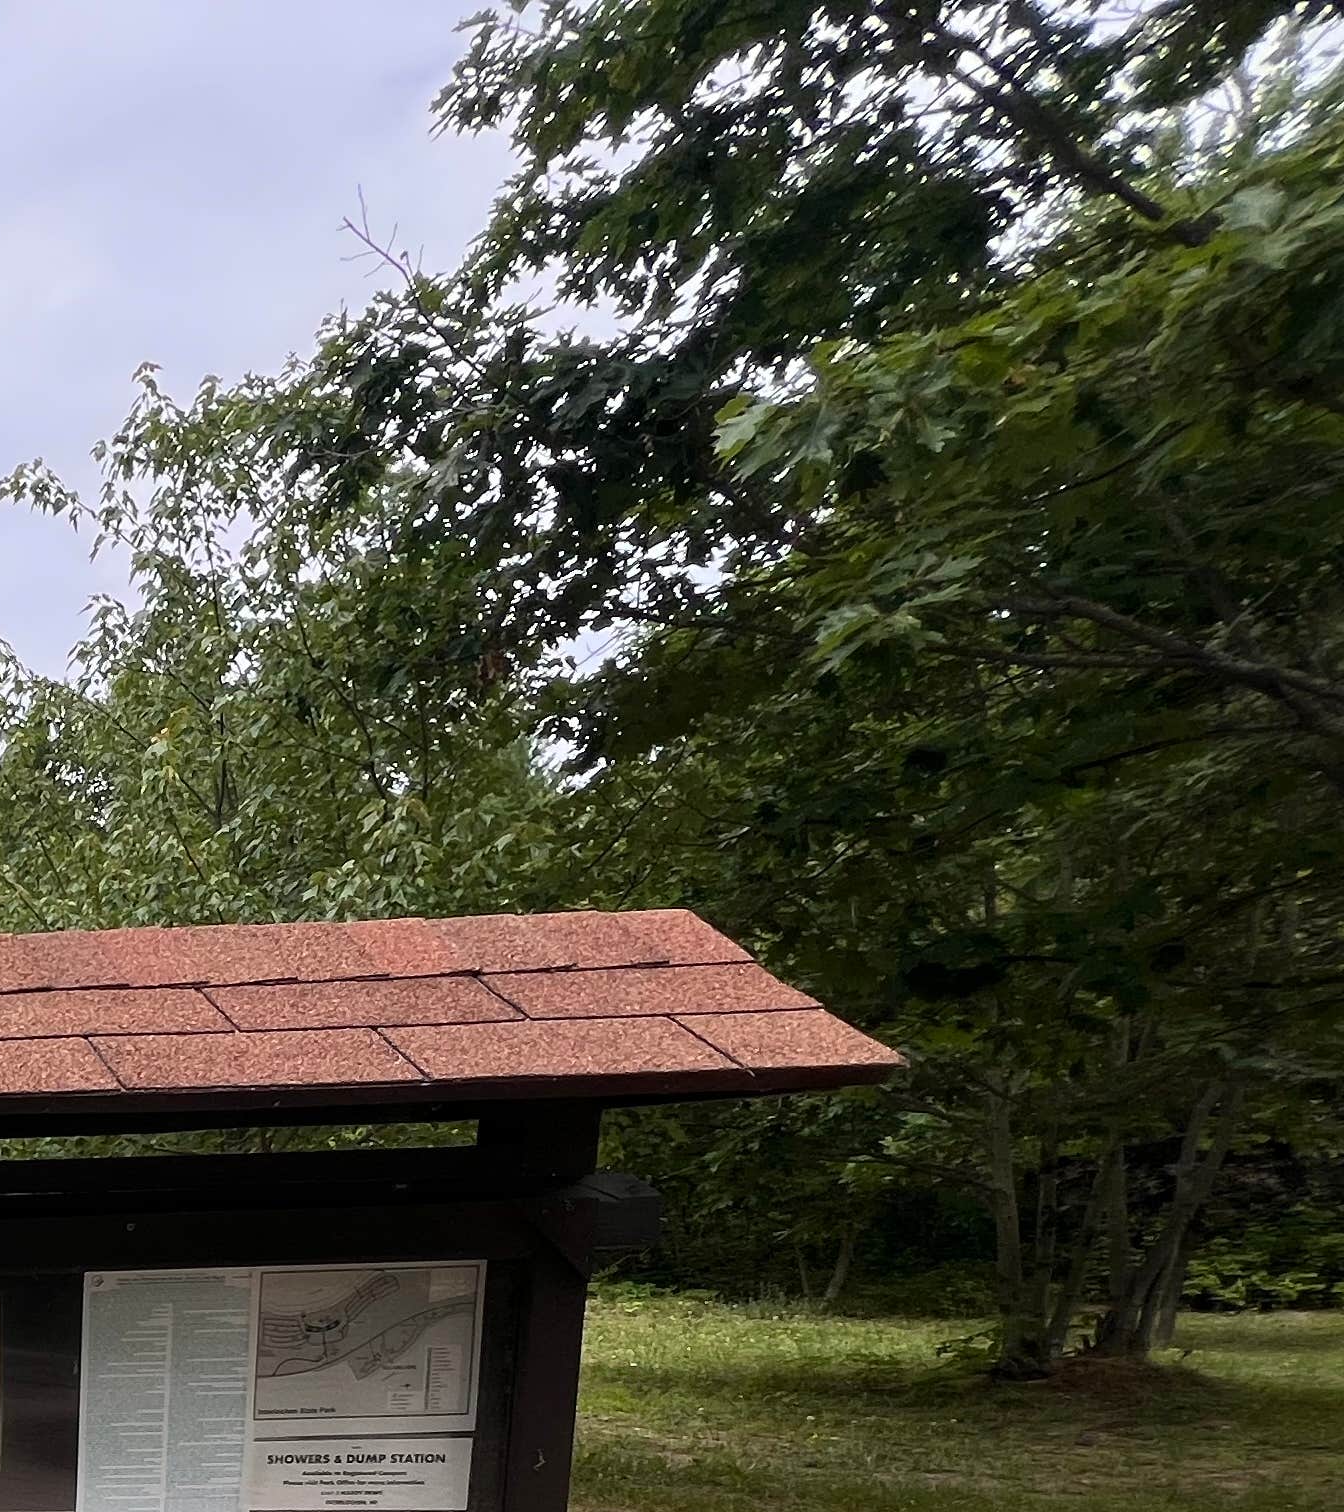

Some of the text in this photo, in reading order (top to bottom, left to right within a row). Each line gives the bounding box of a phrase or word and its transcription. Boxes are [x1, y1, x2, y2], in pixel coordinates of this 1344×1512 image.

[267, 1454, 447, 1464] SHOWERS & DUMP STATION
